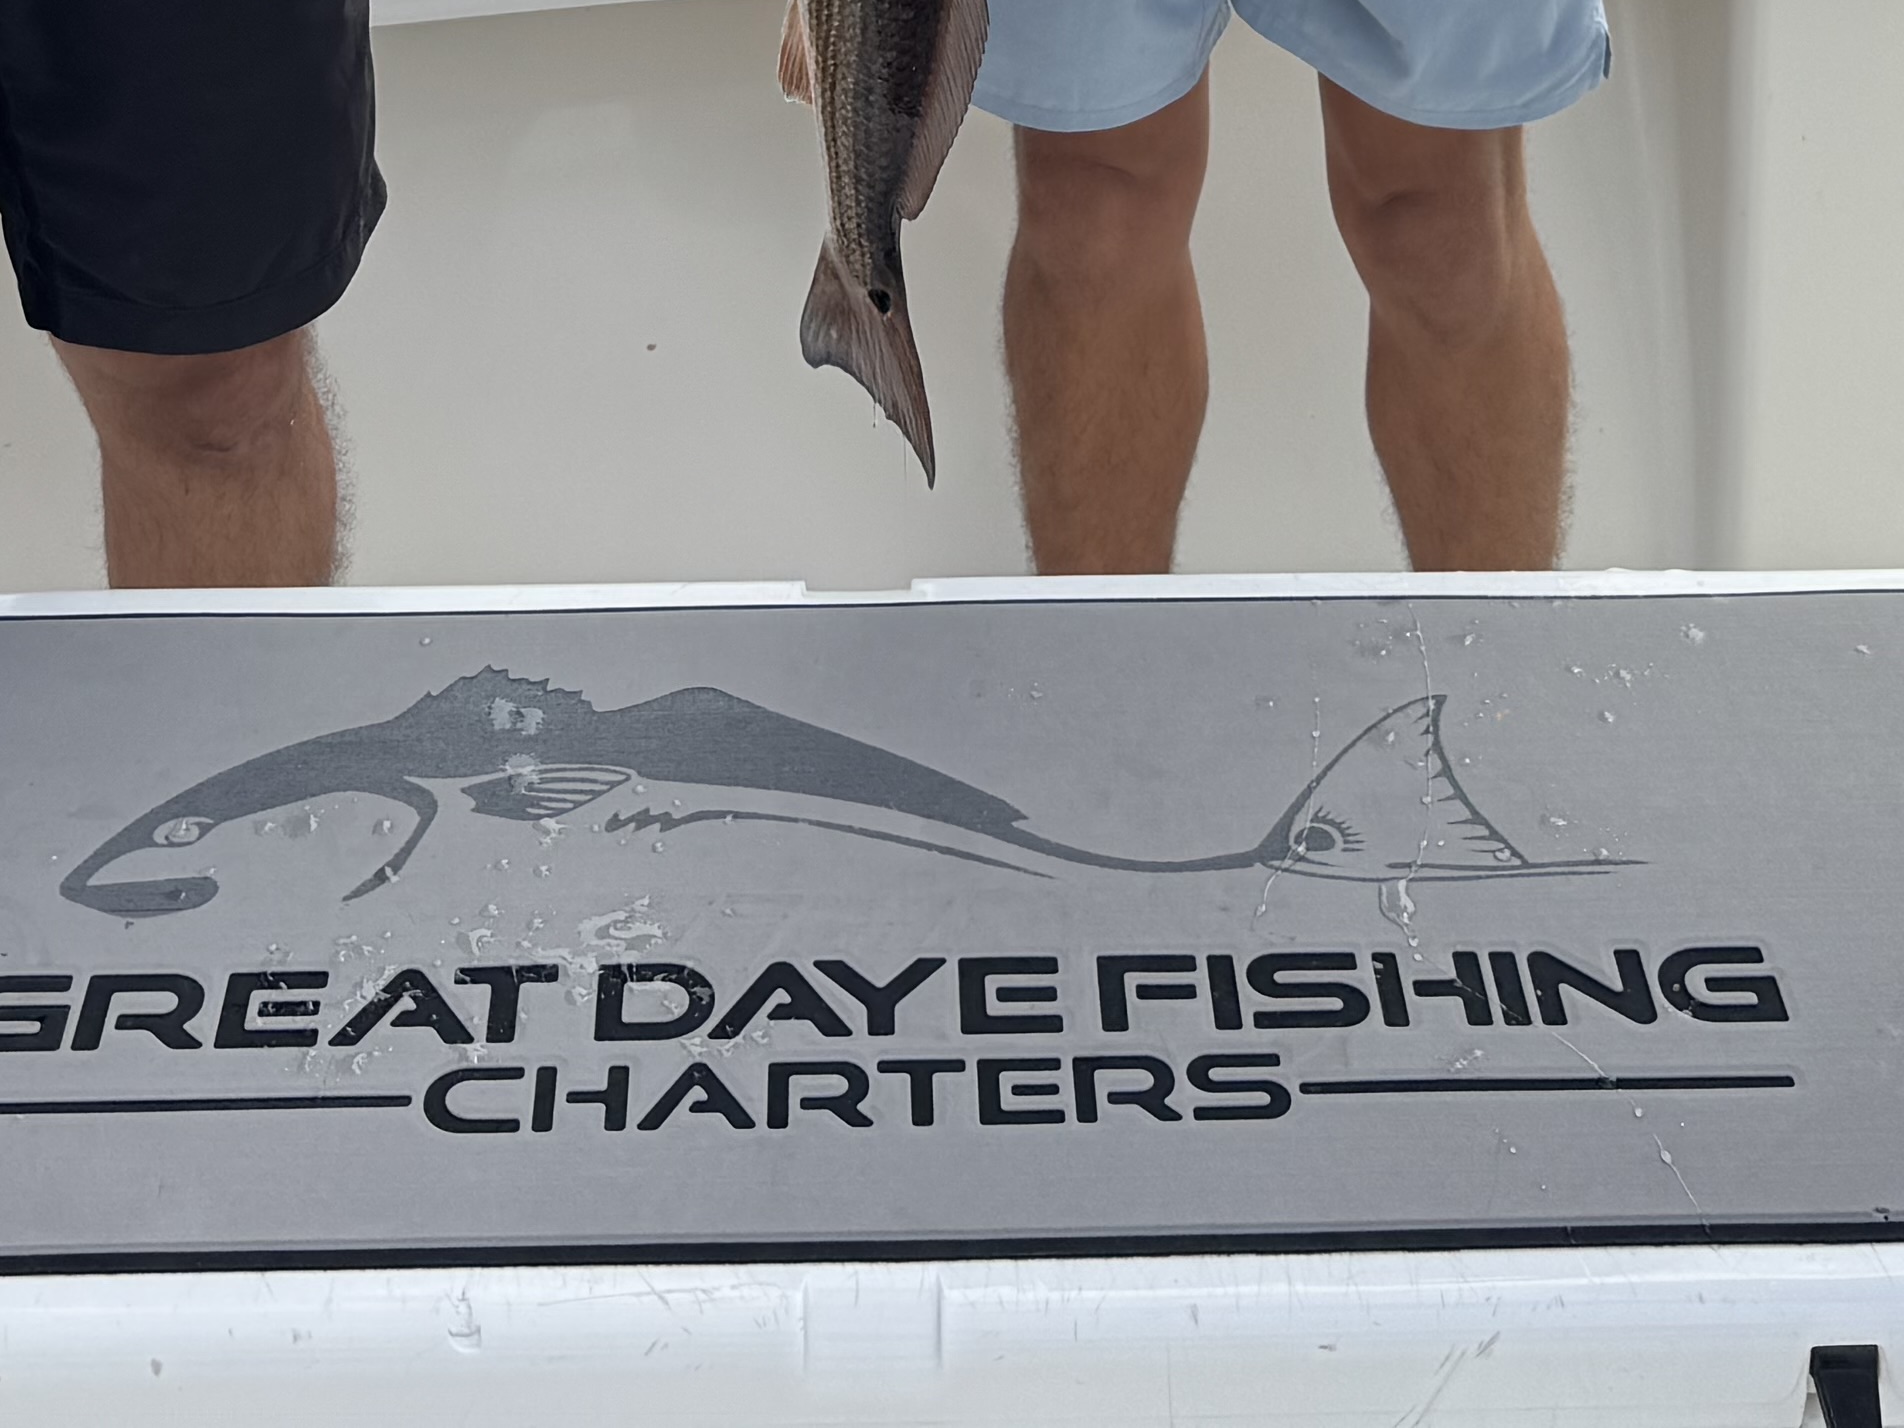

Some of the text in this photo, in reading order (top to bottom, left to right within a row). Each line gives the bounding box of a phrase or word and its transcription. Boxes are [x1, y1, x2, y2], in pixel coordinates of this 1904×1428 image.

[592, 955, 1065, 1043] DAYE
[1095, 945, 1791, 1034] FISHING
[422, 1052, 1293, 1135] CHARTERS
